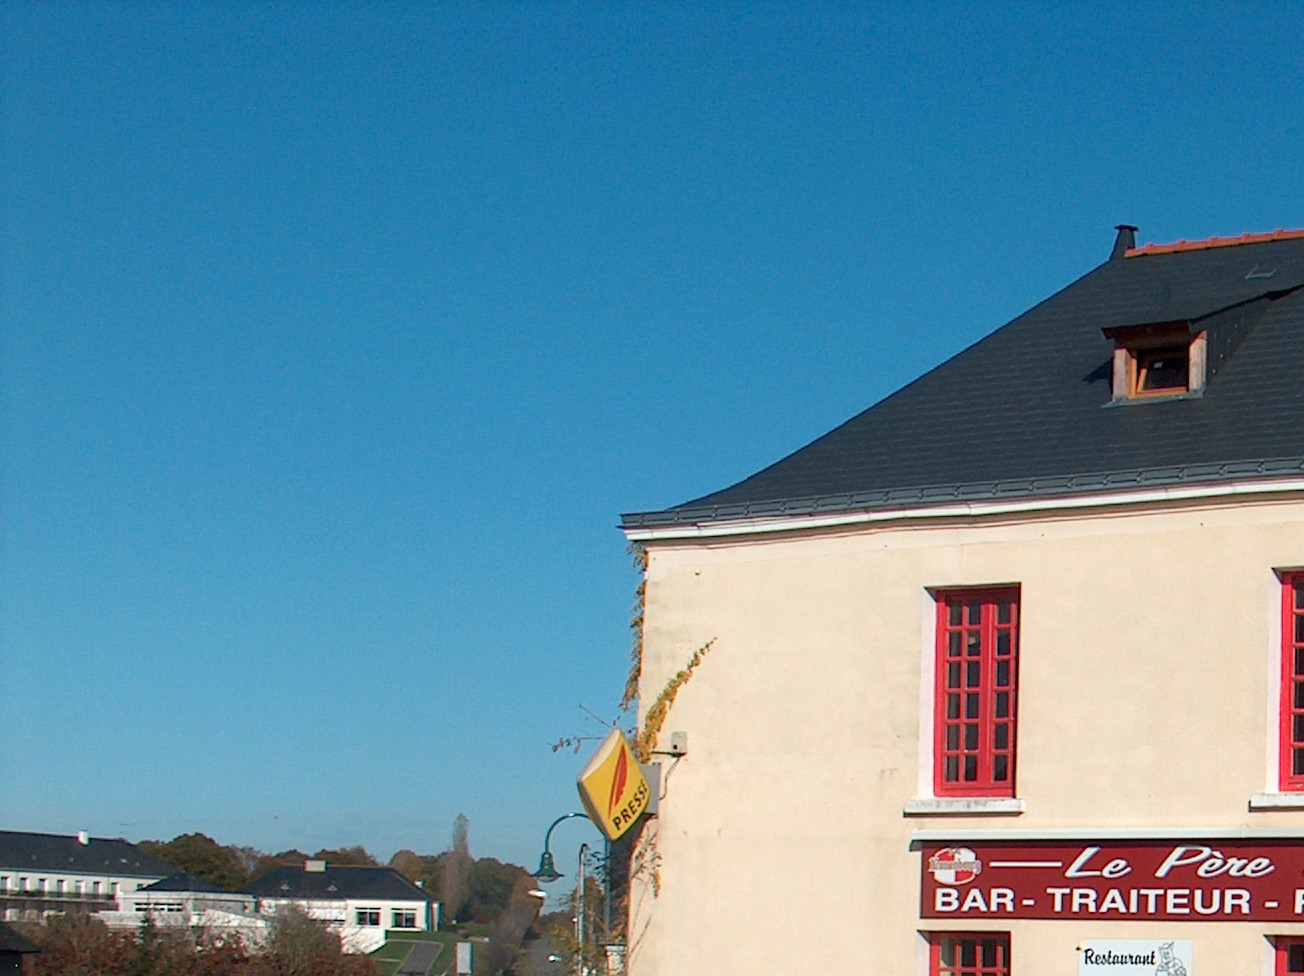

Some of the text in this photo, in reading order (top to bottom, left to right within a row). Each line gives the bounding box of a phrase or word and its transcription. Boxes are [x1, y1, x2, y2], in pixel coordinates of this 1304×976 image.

[1064, 845, 1133, 879] Le
[1155, 845, 1275, 879] Père
[934, 887, 1014, 913] BAR
[1047, 888, 1251, 915] TRAITEUR
[1084, 948, 1156, 966] Restaurant
